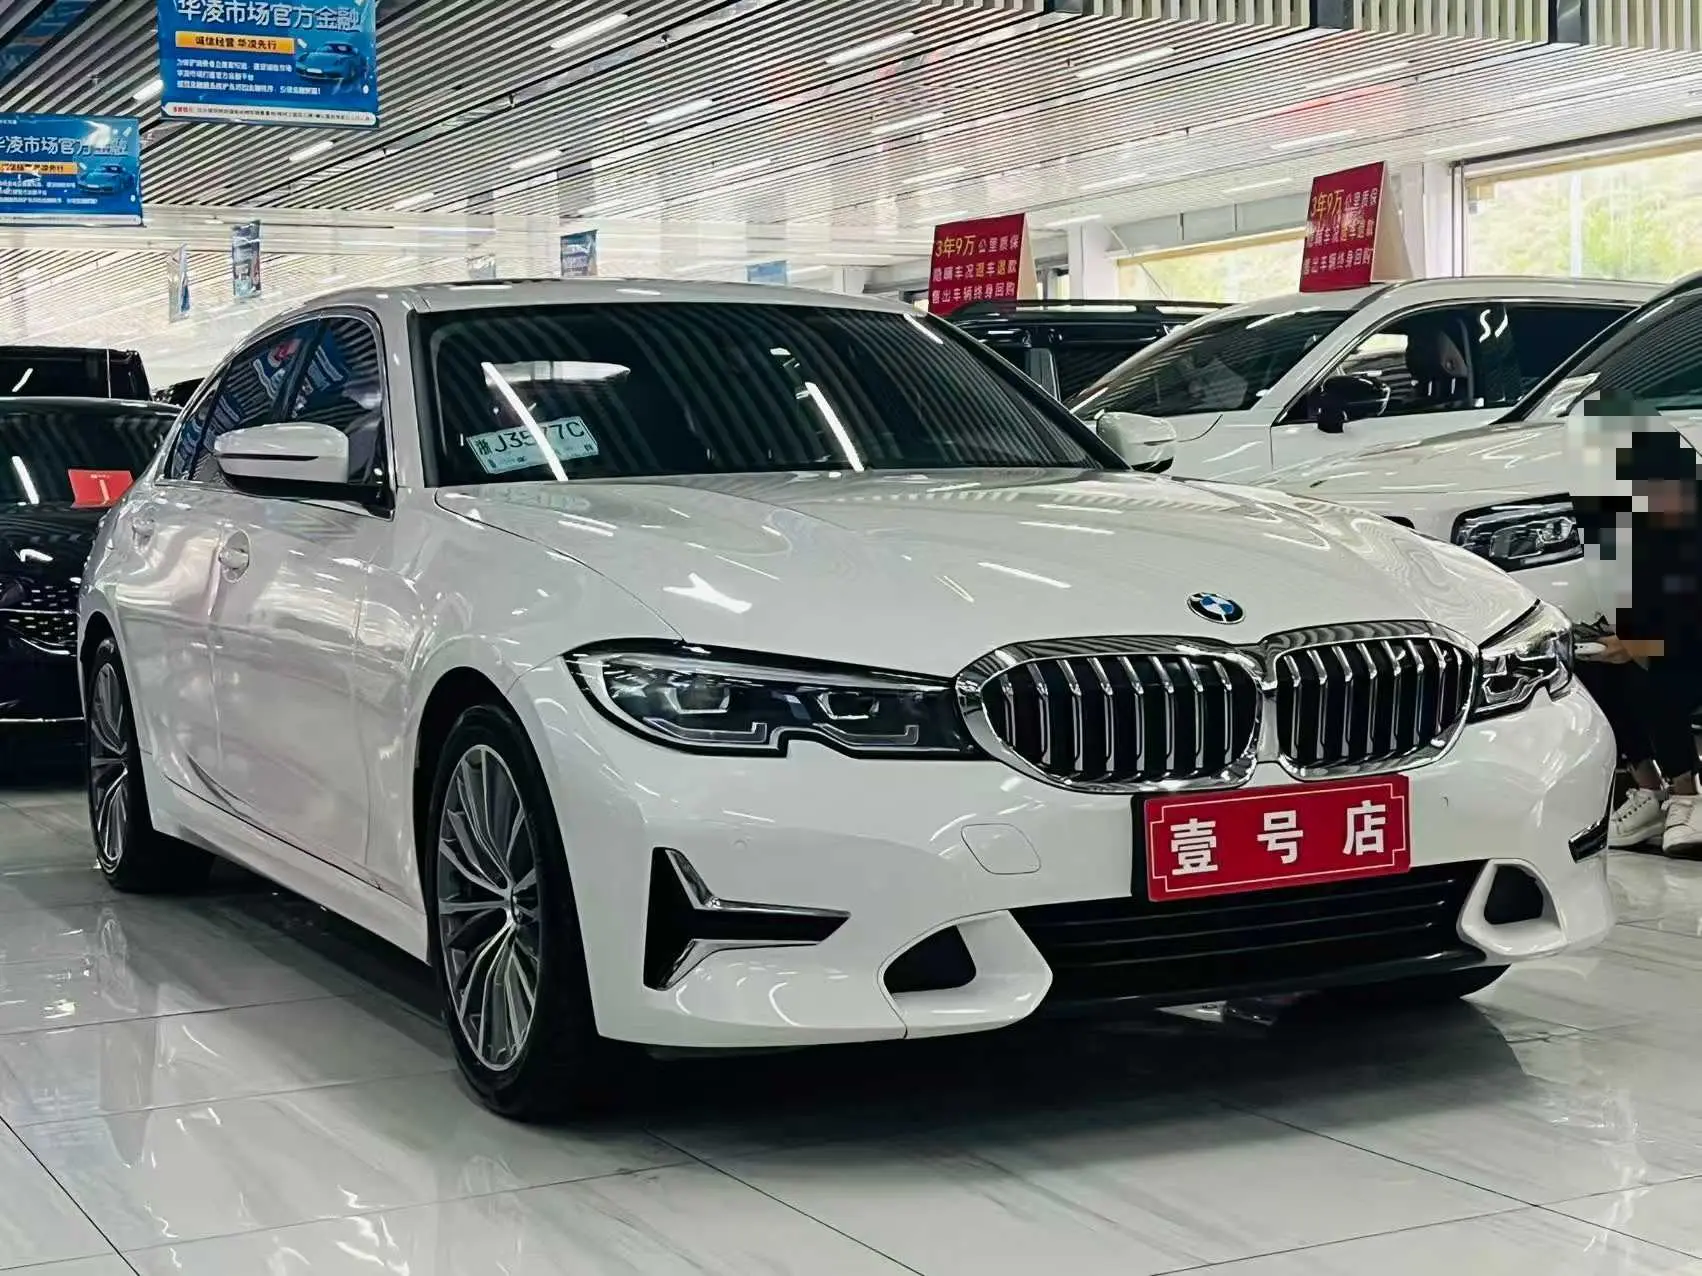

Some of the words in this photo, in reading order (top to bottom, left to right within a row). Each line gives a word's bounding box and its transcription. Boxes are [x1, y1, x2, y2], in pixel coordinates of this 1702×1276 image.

[178, 0, 360, 31] 华凌市场官方金融
[935, 233, 1019, 259] 3年9万公里质保
[931, 281, 1016, 305] 售出车辆终身回购
[1169, 799, 1387, 876] 壹号店
